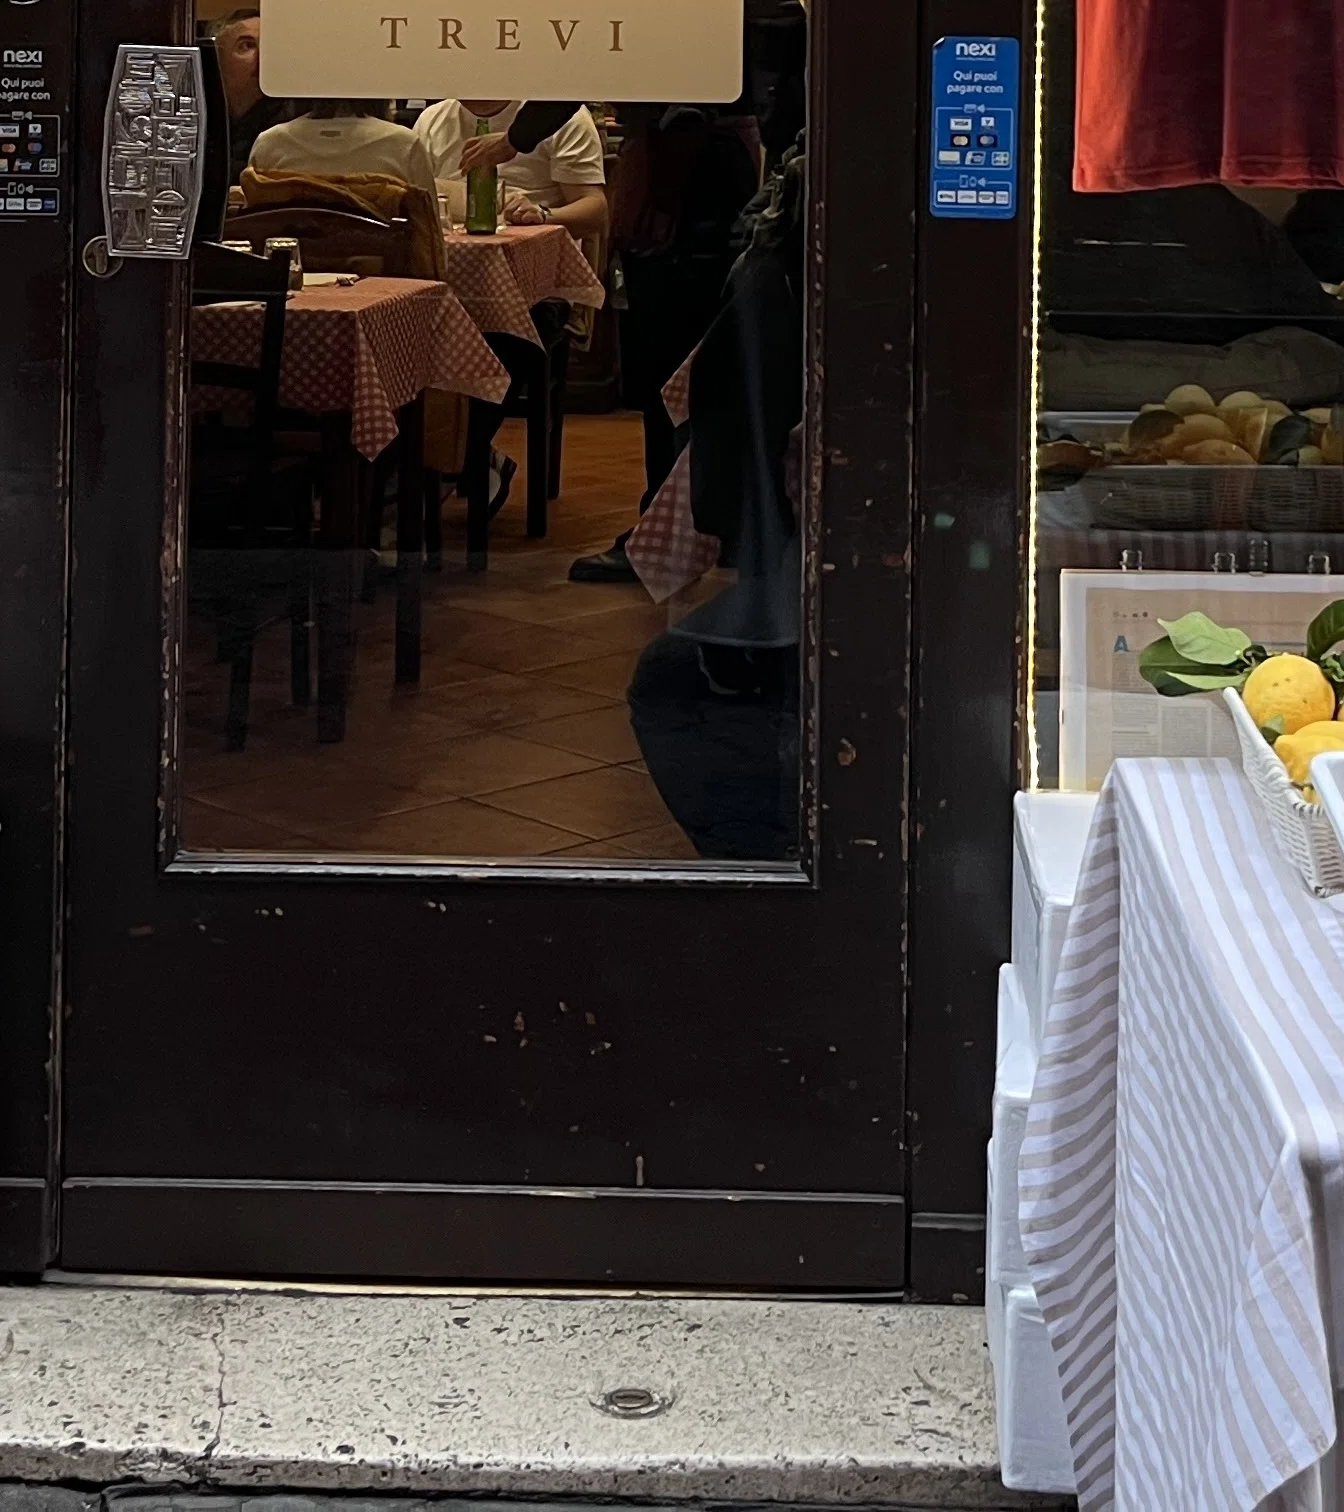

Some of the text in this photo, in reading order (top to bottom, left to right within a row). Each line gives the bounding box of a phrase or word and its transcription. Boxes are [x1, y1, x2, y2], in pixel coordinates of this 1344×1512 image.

[380, 16, 624, 52] TREVI
[3, 49, 43, 63] nexi
[955, 42, 997, 57] nexi
[953, 70, 998, 82] Qui puoi
[0, 77, 45, 90] Qui puoi
[946, 84, 1005, 96] pagare con
[31, 91, 51, 101] con
